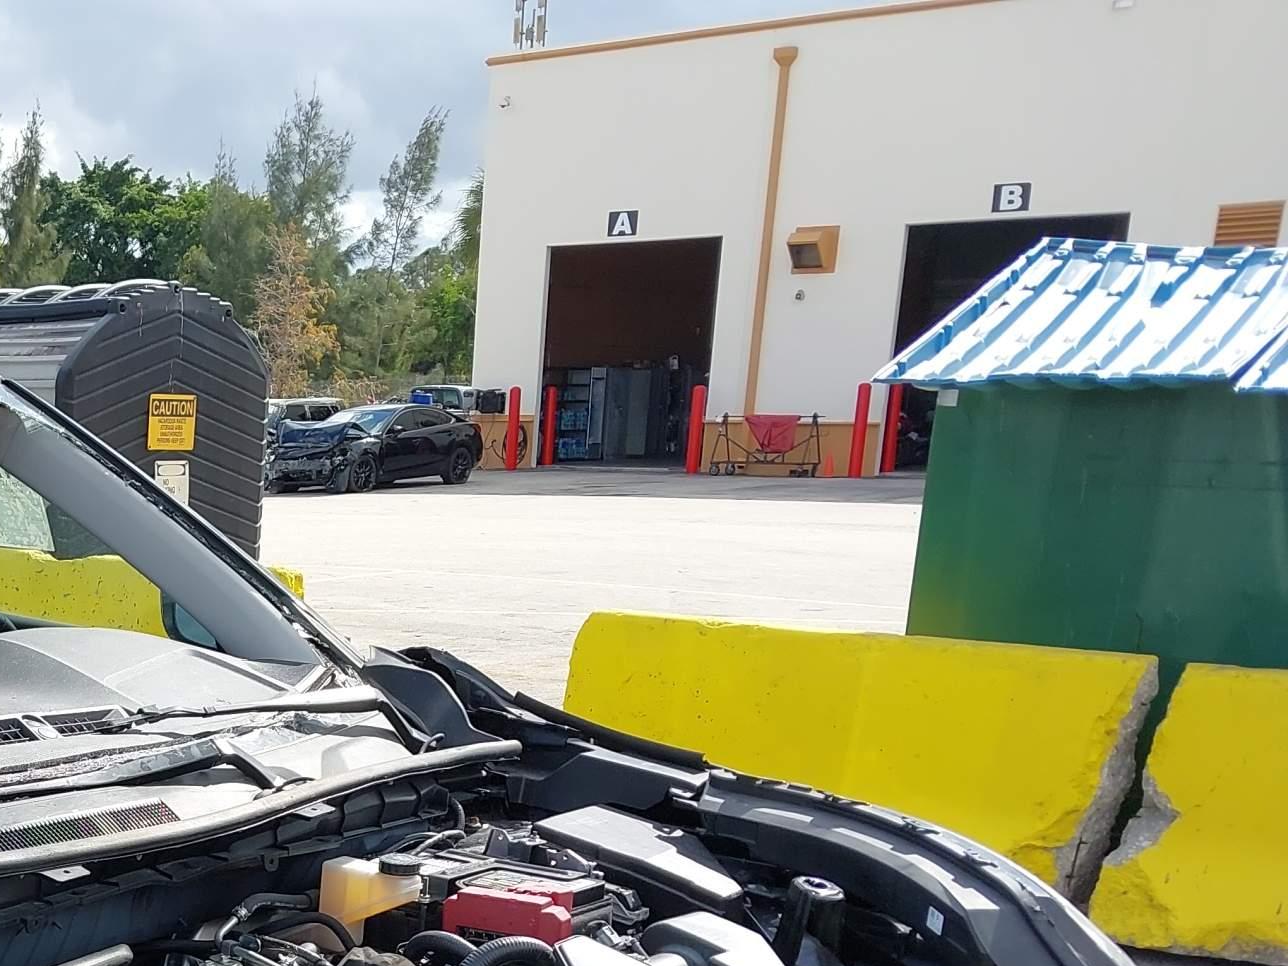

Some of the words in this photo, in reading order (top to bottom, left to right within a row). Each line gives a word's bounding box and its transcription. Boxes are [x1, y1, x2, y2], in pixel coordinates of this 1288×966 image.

[1000, 185, 1023, 210] B
[612, 212, 632, 235] A
[152, 400, 193, 416] CAUTION
